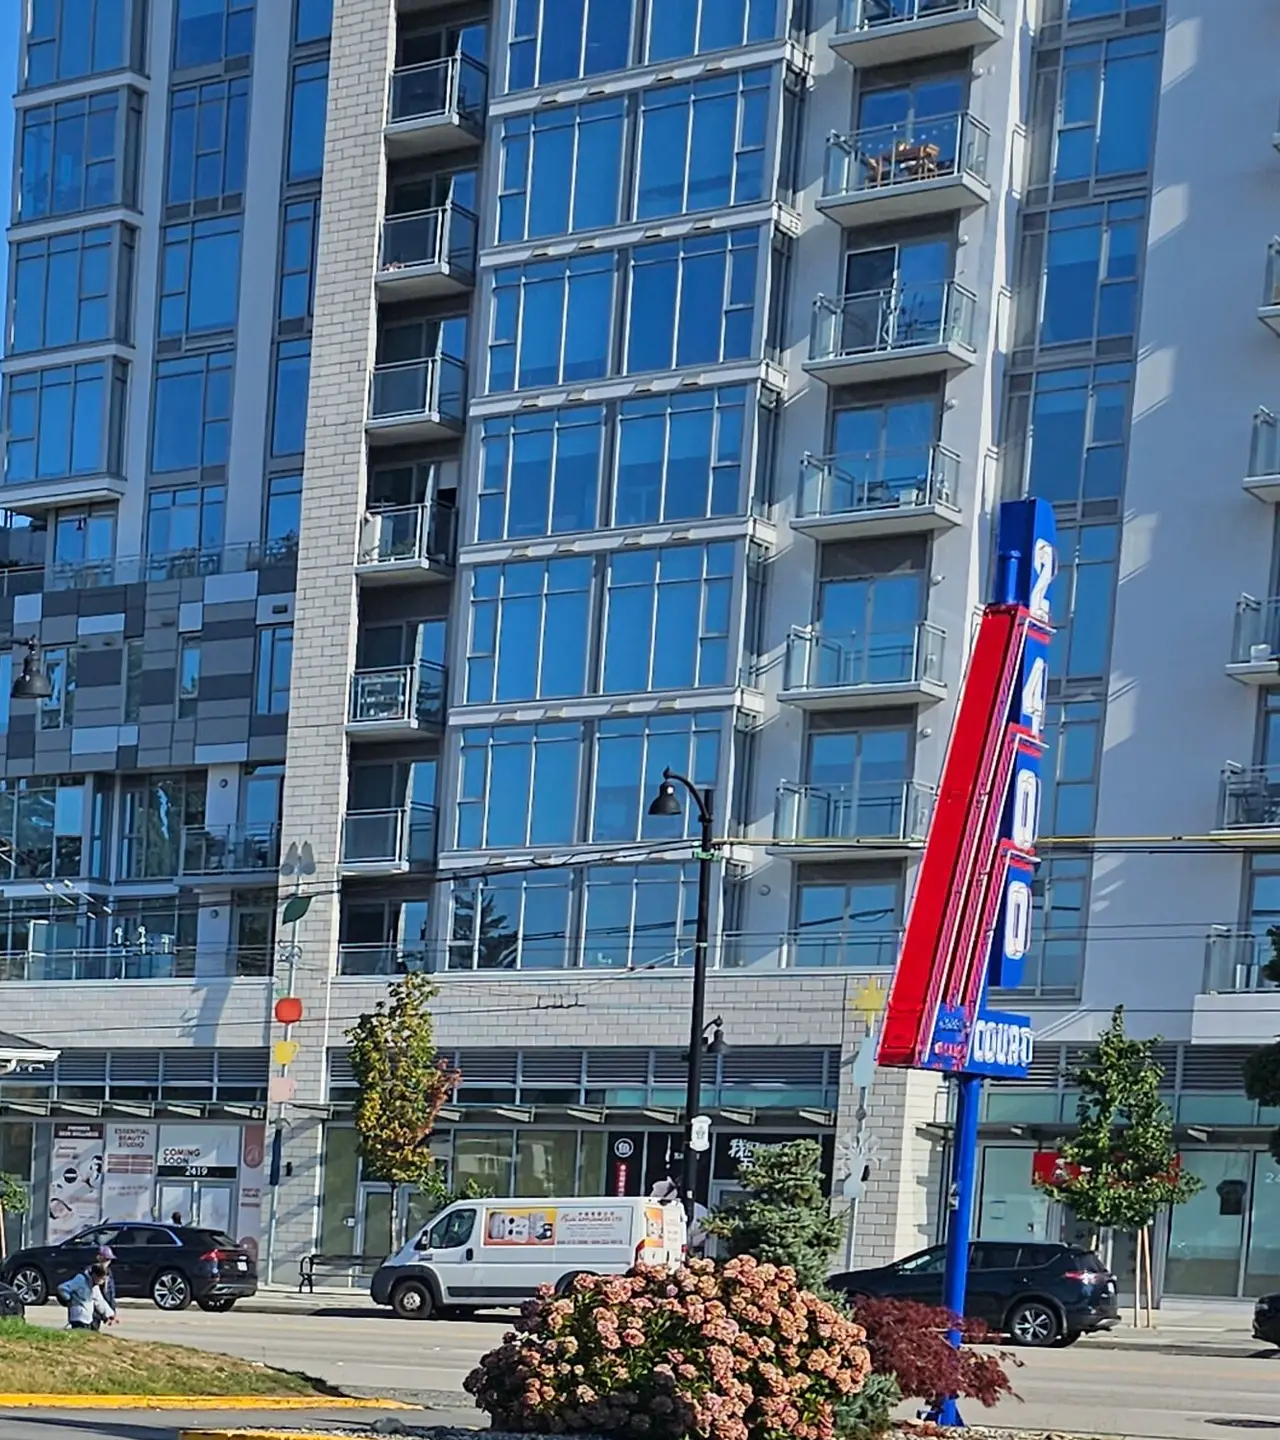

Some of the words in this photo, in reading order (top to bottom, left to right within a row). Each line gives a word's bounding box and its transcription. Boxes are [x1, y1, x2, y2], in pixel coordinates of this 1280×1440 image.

[1003, 538, 1058, 960] 2400
[163, 1148, 200, 1157] COMING
[163, 1157, 189, 1165] SOON
[184, 1166, 208, 1176] 2419
